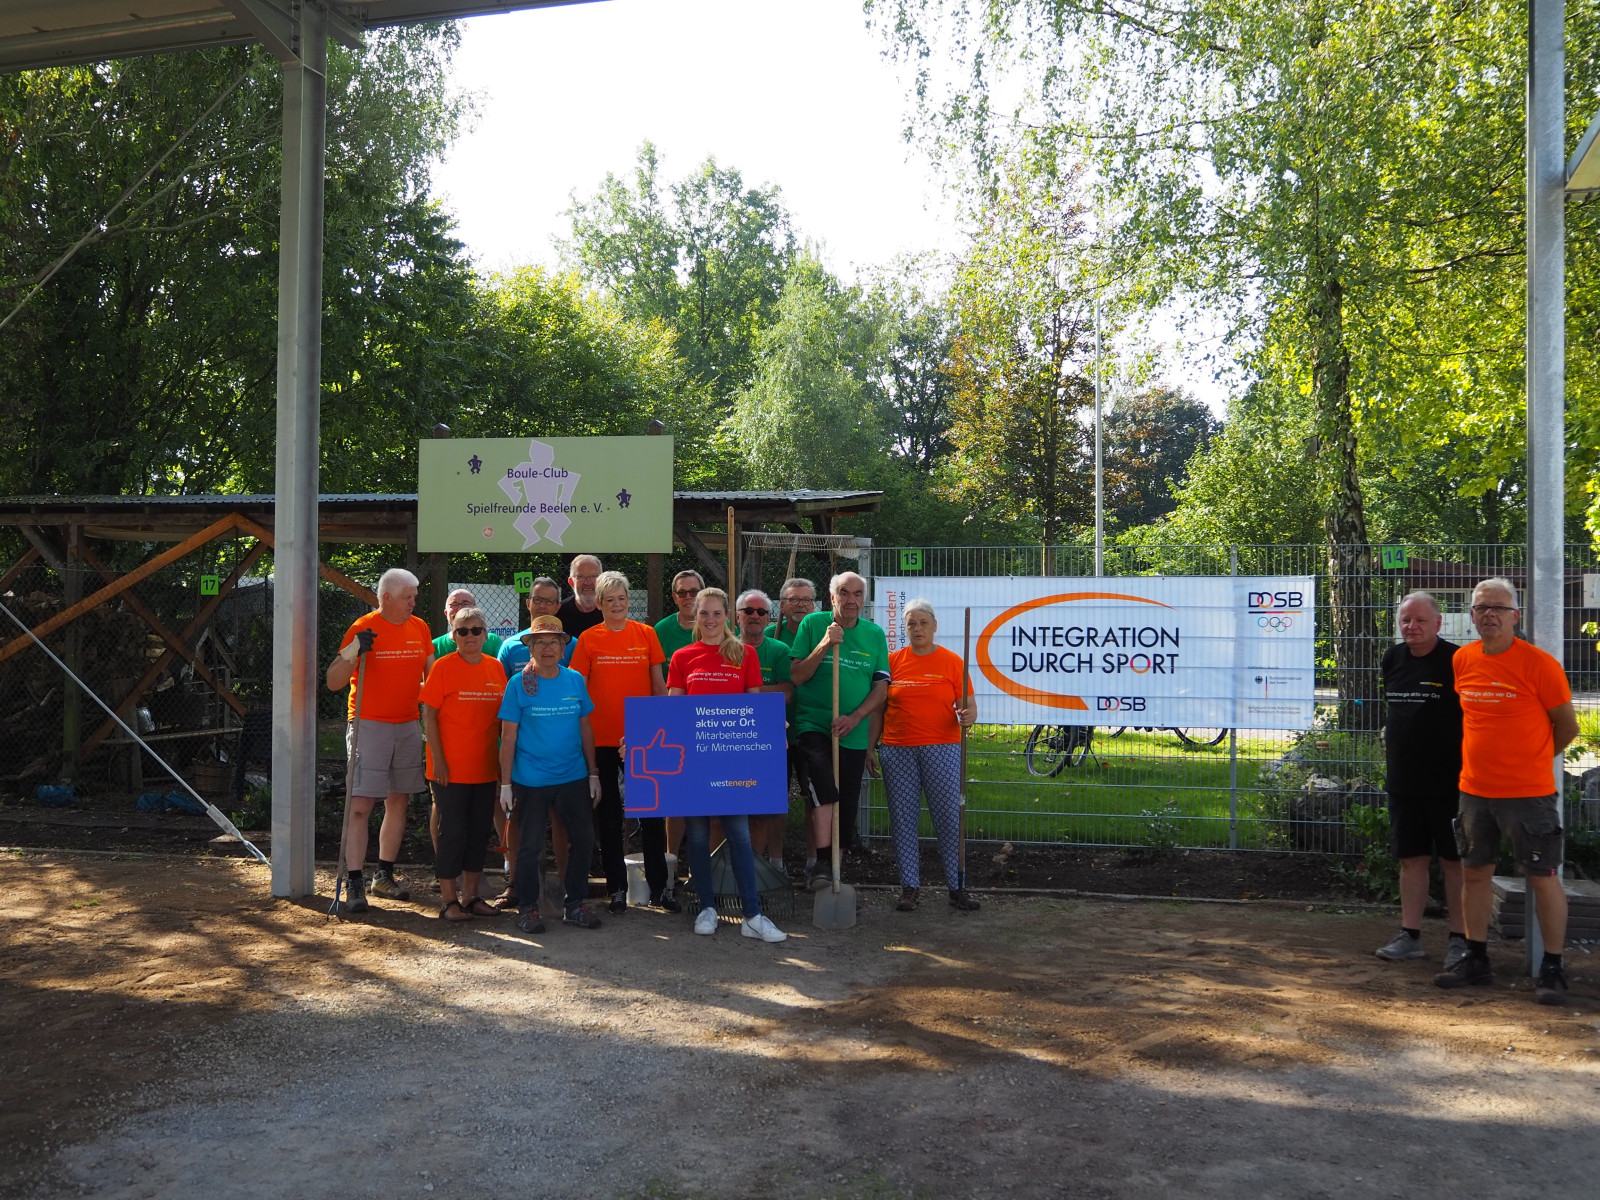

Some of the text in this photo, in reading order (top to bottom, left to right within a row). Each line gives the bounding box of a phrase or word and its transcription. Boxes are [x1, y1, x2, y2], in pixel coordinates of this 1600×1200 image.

[507, 467, 568, 479] Boule-Club
[467, 503, 603, 516] Spielfreunde Beelen e. V.
[903, 552, 919, 566] 15
[1383, 549, 1404, 564] 14
[203, 579, 216, 591] 17
[516, 576, 531, 588] 16
[1248, 591, 1303, 608] DOSB
[1012, 627, 1179, 647] INTEGRATION
[1012, 652, 1179, 674] DURCH SPORT
[1097, 696, 1146, 711] DOSB
[695, 706, 754, 717] Westenergie
[696, 717, 756, 728] aktiv vor Ort
[696, 730, 758, 740] Mitarbeitende
[696, 742, 772, 753] für Mitmenschen
[710, 778, 757, 788] westenergie
